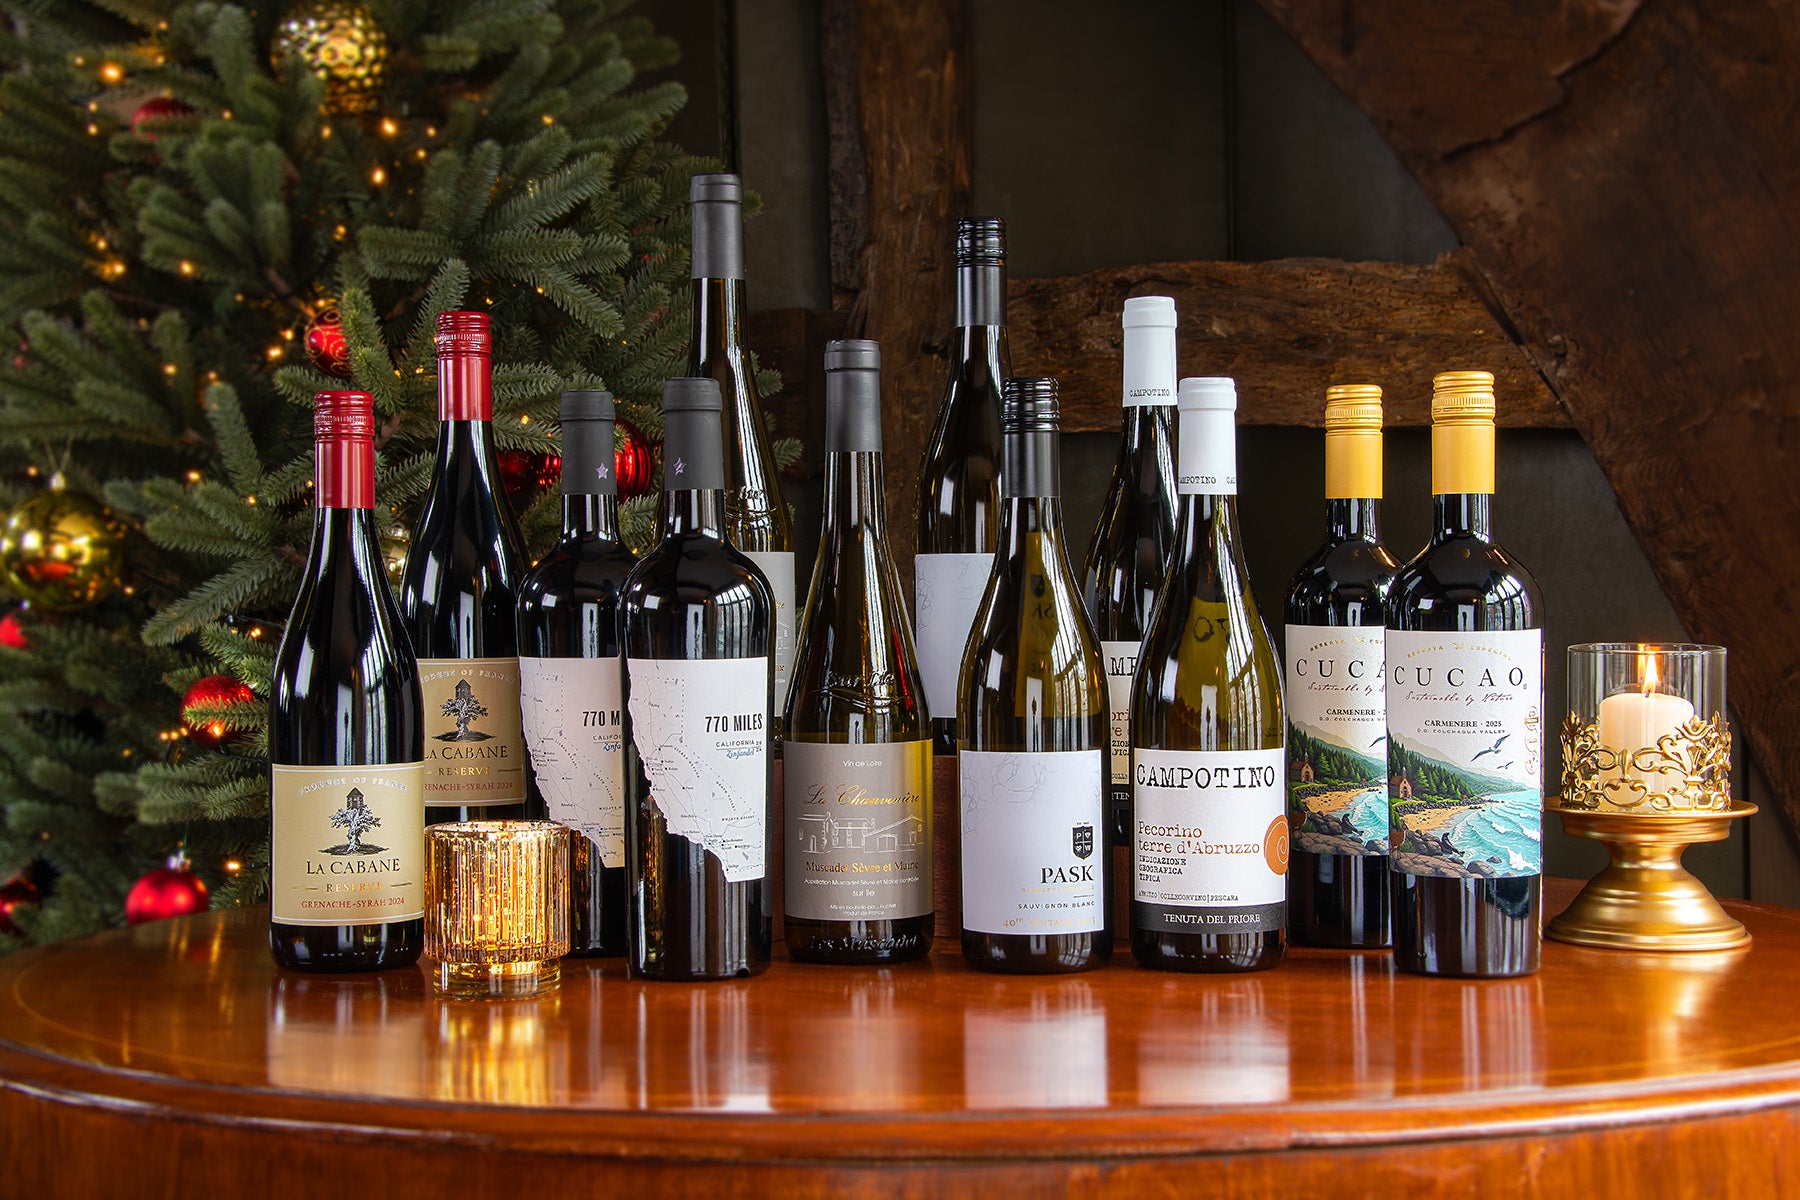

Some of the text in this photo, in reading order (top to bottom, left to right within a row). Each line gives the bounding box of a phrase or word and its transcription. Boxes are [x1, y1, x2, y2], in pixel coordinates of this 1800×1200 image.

[1394, 665, 1523, 687] CUCAO
[1326, 708, 1376, 716] CARMENERE
[582, 710, 606, 727] 770
[704, 713, 763, 733] 770 MILES
[1424, 719, 1502, 728] CARMENERE 2025
[715, 740, 755, 748] CALIFORNIA
[441, 744, 509, 761] CABANE
[1136, 763, 1275, 789] CAMPOTINO
[496, 781, 514, 790] 2024
[1138, 820, 1203, 838] Pecorino
[1138, 840, 1260, 855] terre d'Abruzzo
[1139, 855, 1187, 866] INDICAZIONE
[330, 858, 402, 876] CABANE
[806, 861, 849, 873] Muscadet
[1138, 864, 1183, 875] GEOGRAFICA
[1041, 865, 1094, 884] PASK
[1139, 873, 1161, 883] TIPICA
[301, 897, 406, 909] GRENACHE-SYRAH 2024
[1163, 914, 1260, 924] TENUTA DEL PRIORE
